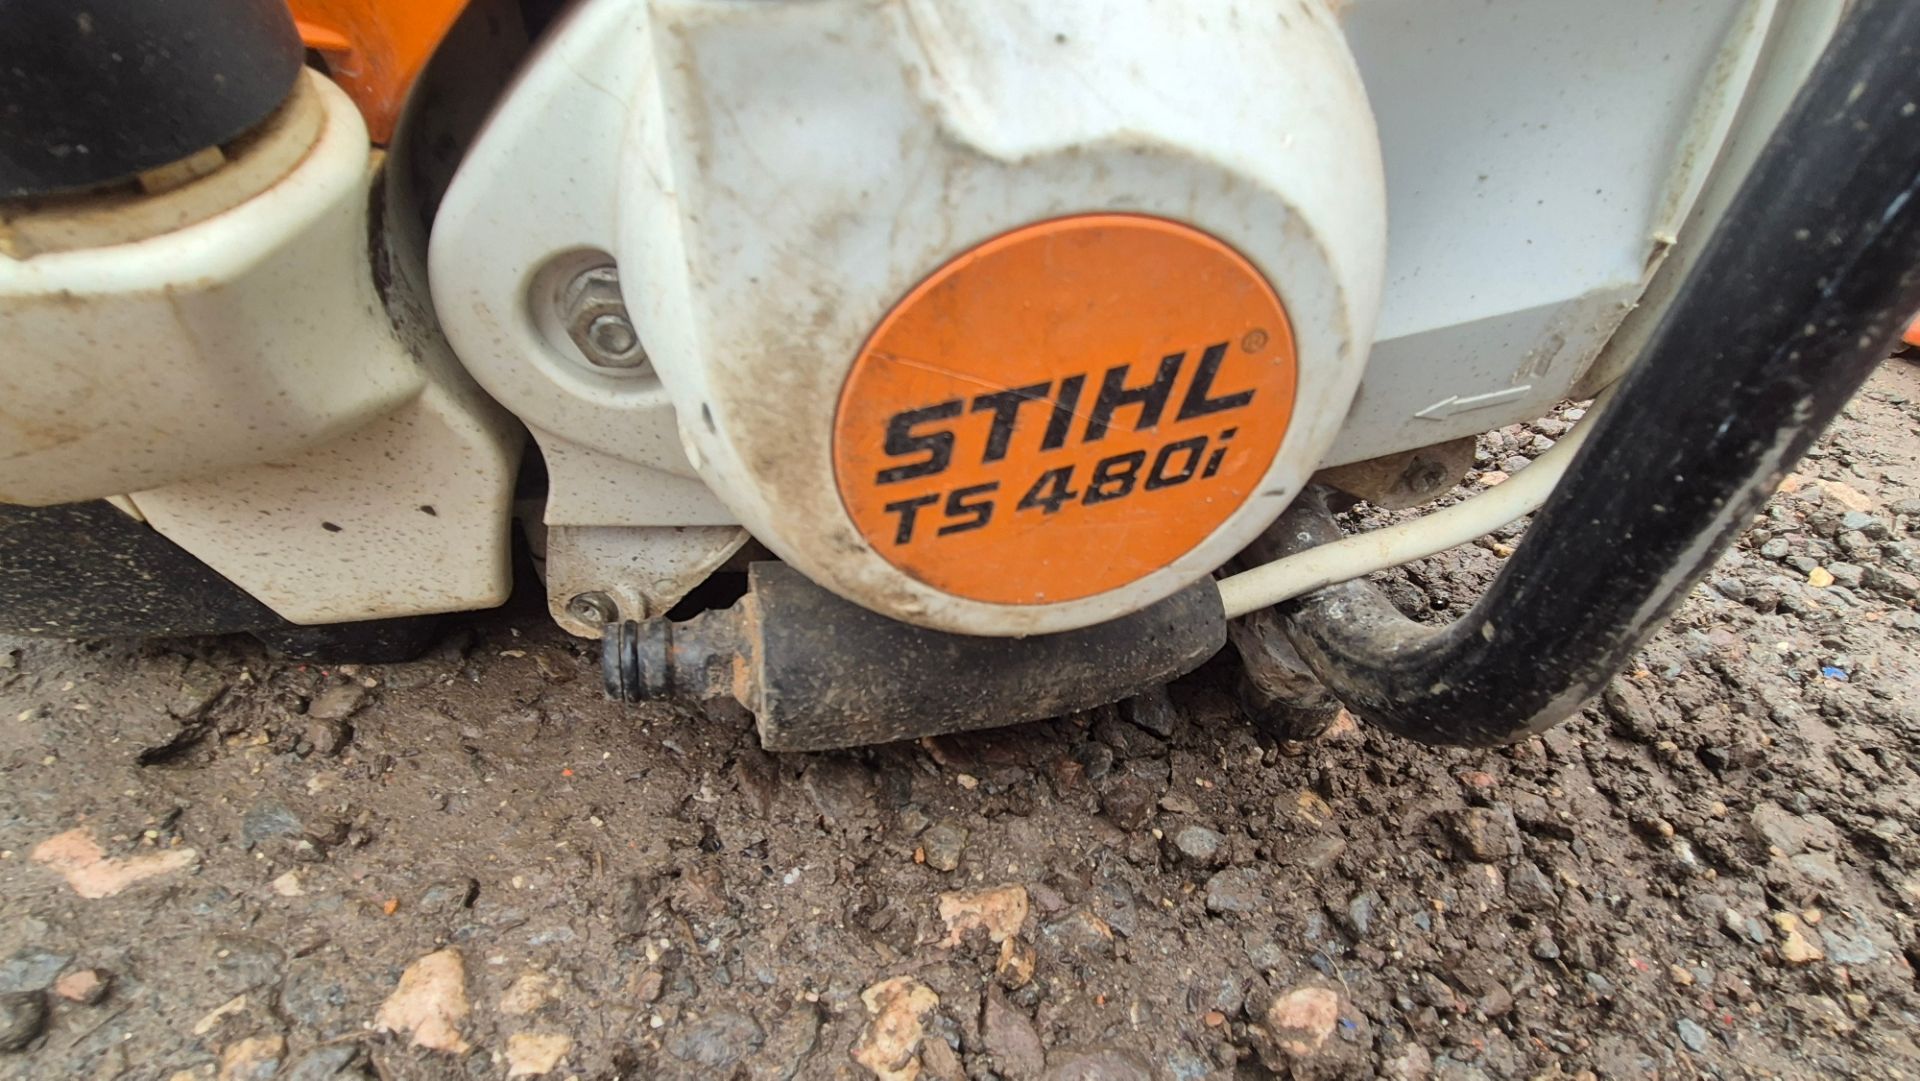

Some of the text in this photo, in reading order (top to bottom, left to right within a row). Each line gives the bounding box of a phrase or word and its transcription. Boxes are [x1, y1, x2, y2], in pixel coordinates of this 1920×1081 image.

[875, 341, 1257, 486] STIHL
[883, 427, 1239, 546] TS 480i
